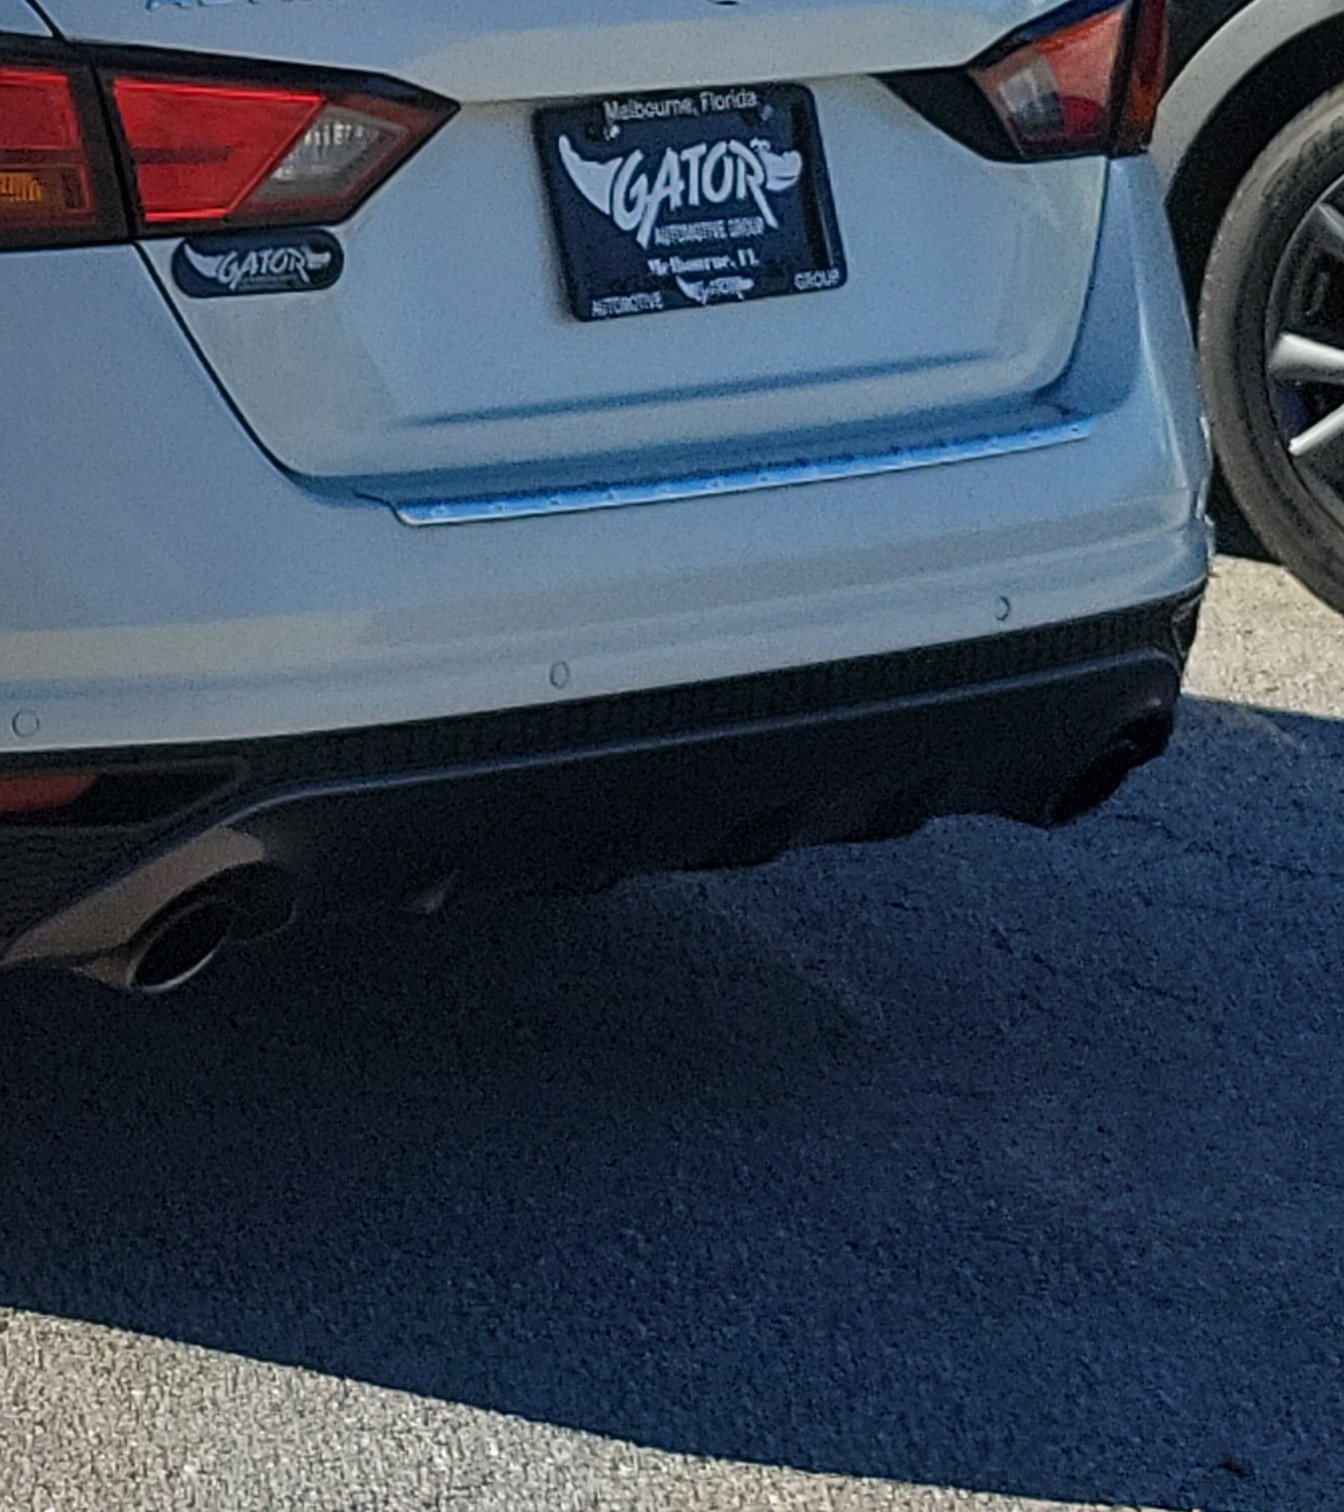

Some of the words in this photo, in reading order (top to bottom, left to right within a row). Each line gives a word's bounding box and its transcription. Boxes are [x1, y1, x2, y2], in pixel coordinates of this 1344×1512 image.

[700, 89, 758, 113] Florida
[613, 139, 779, 250] GATOR
[216, 246, 311, 290] GATOR
